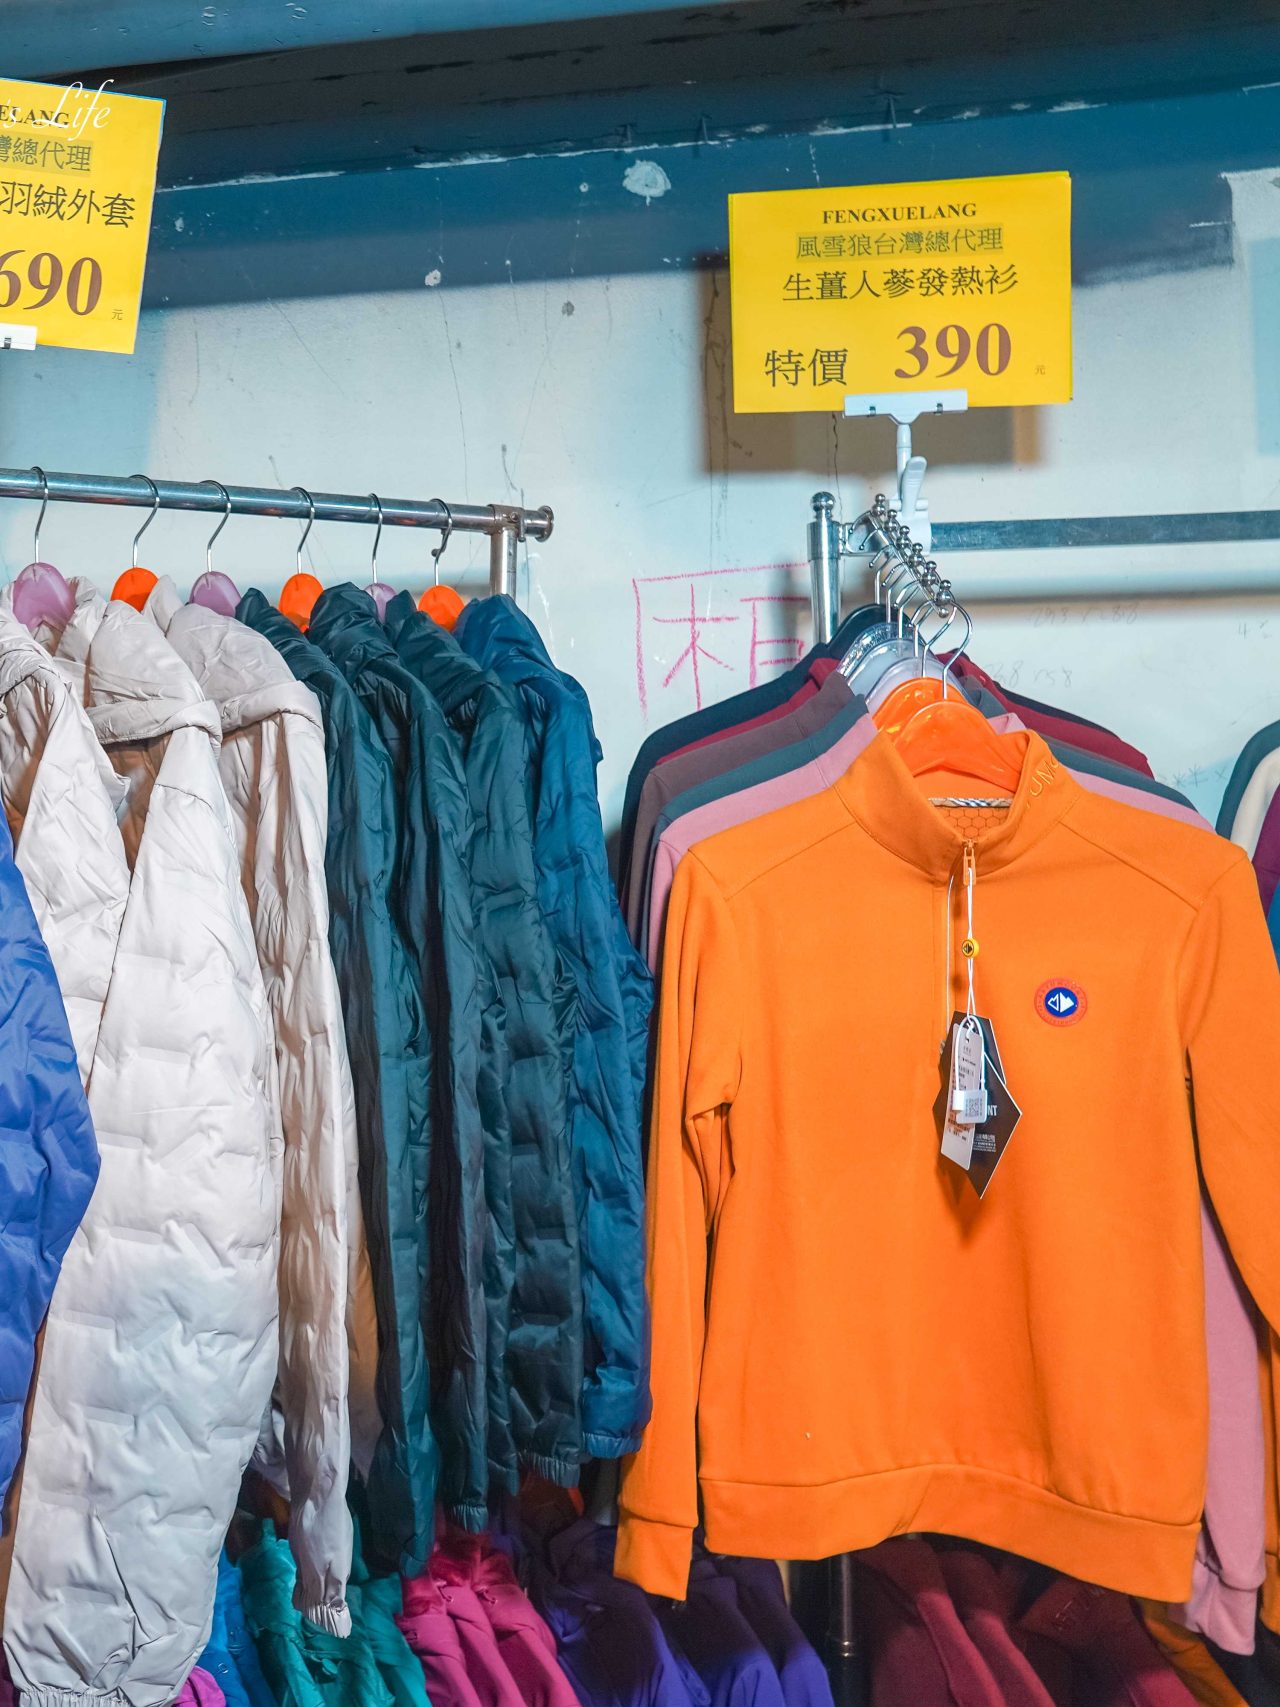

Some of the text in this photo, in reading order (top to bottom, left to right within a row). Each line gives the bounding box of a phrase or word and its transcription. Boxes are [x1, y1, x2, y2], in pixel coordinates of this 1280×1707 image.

[822, 203, 978, 224] FENGXUELANG
[796, 227, 1004, 260] 風雪狼台灣總代理
[782, 264, 1019, 302] 生薑人蔘發熱衫
[111, 309, 124, 321] 元
[764, 323, 1046, 387] 特價 390 元
